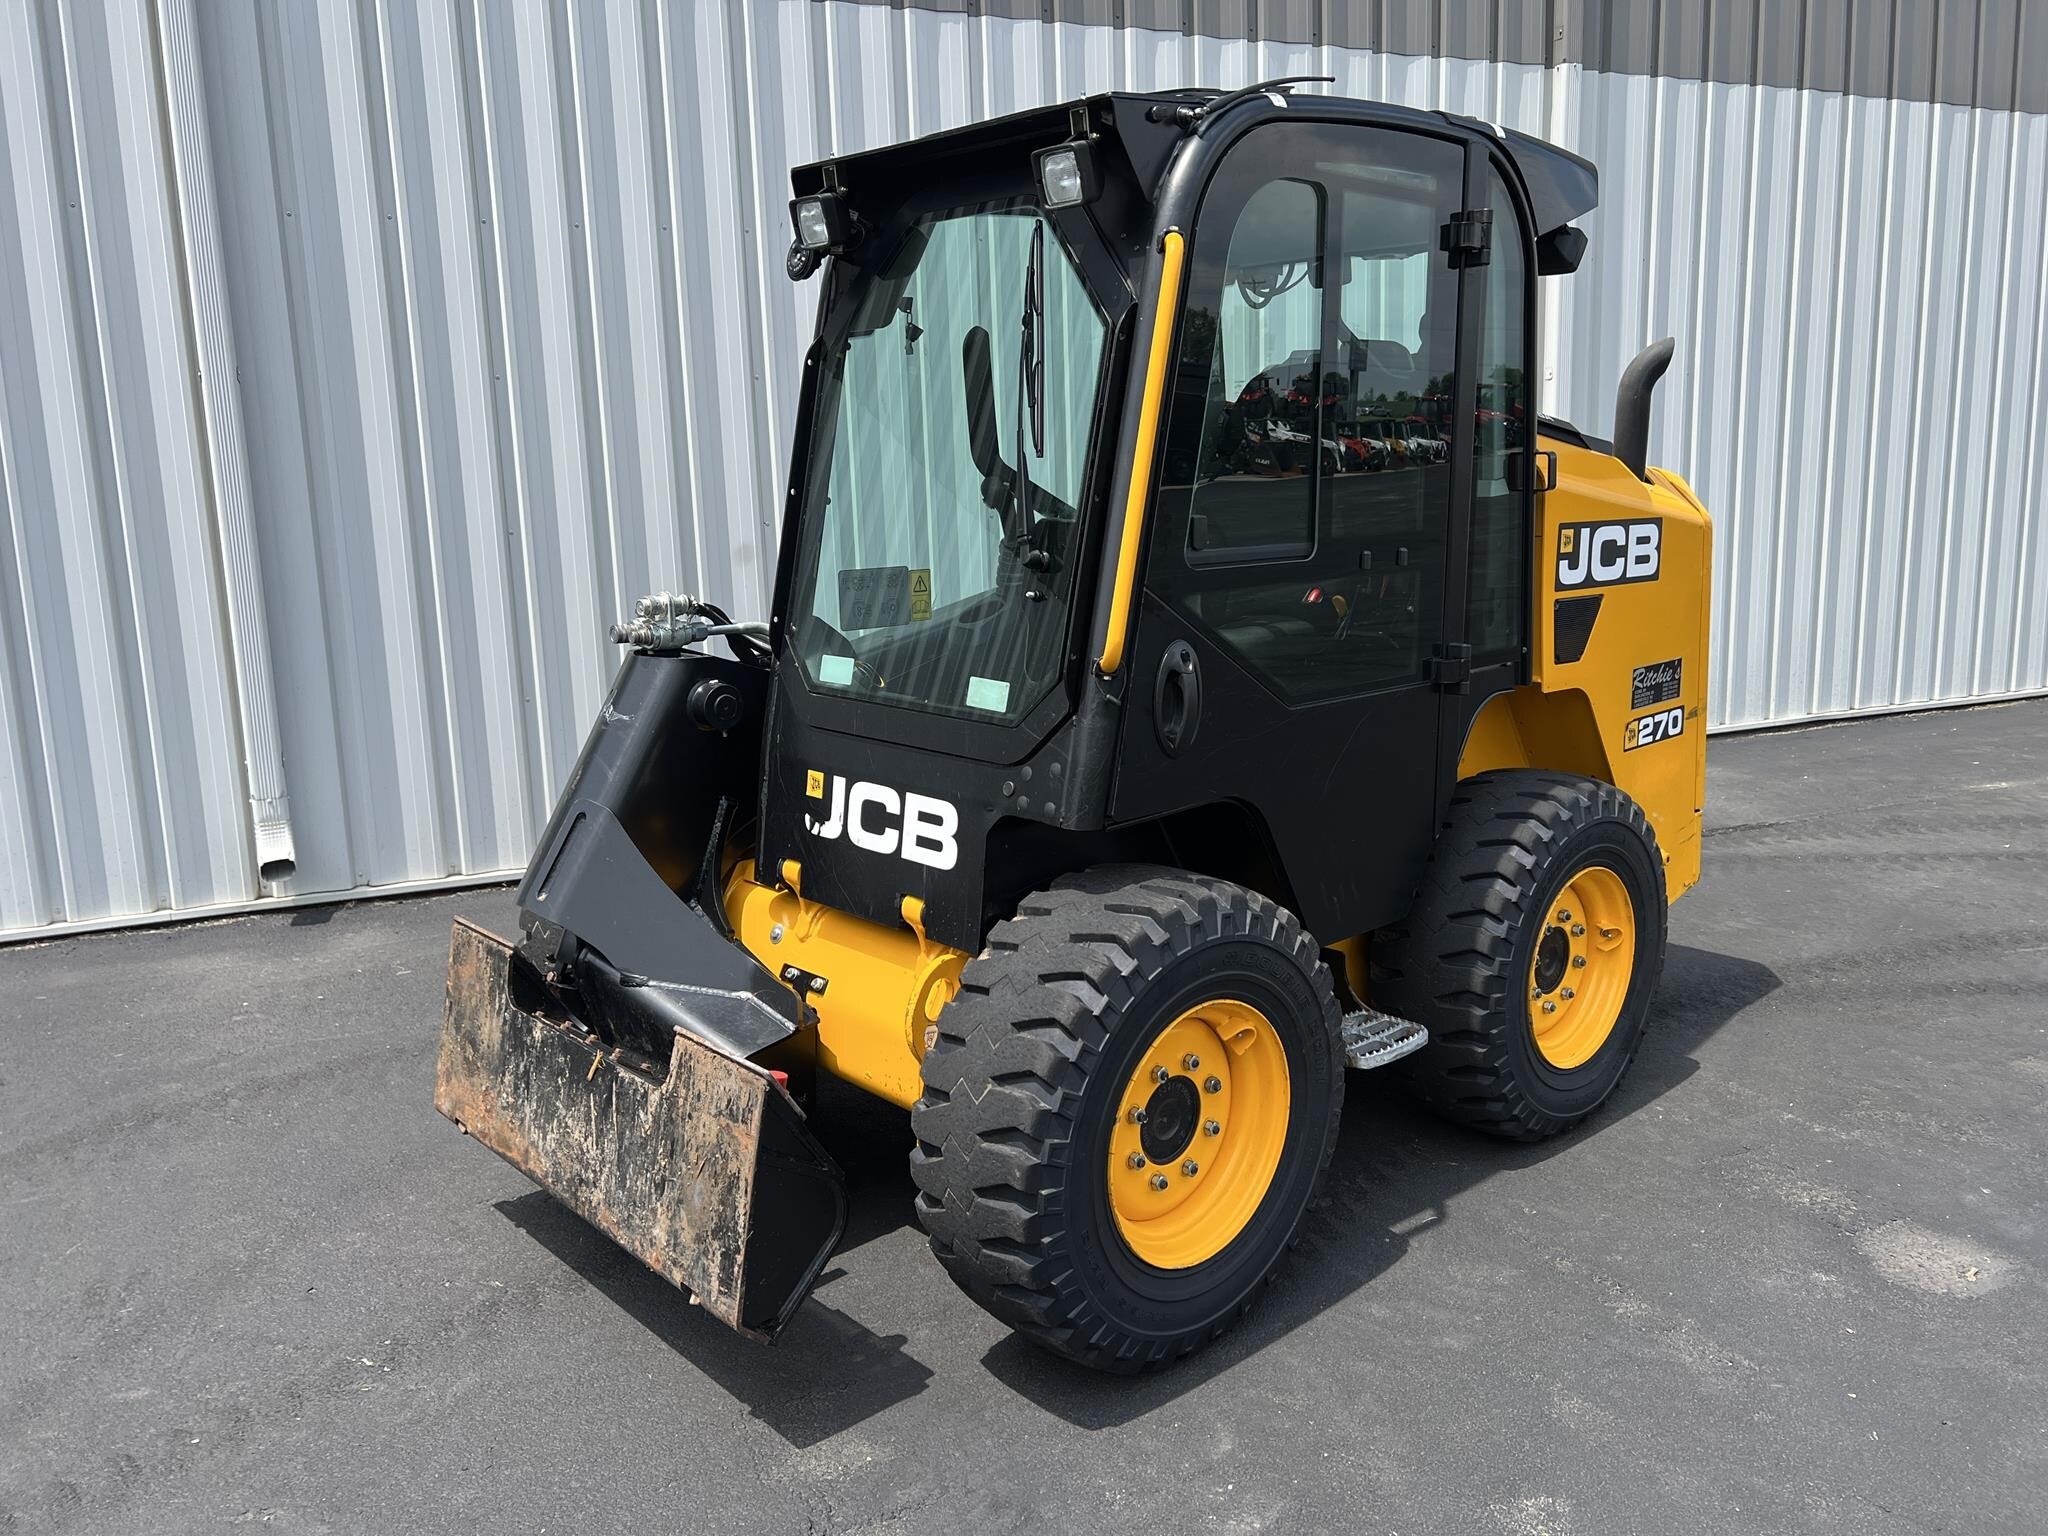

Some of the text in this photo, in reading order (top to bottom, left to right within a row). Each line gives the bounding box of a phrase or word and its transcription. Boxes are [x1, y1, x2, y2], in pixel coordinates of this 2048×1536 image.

[1559, 523, 1660, 585] JCB
[1632, 660, 1681, 691] Ritchie's
[1638, 708, 1683, 746] 270
[804, 775, 959, 871] JCB
